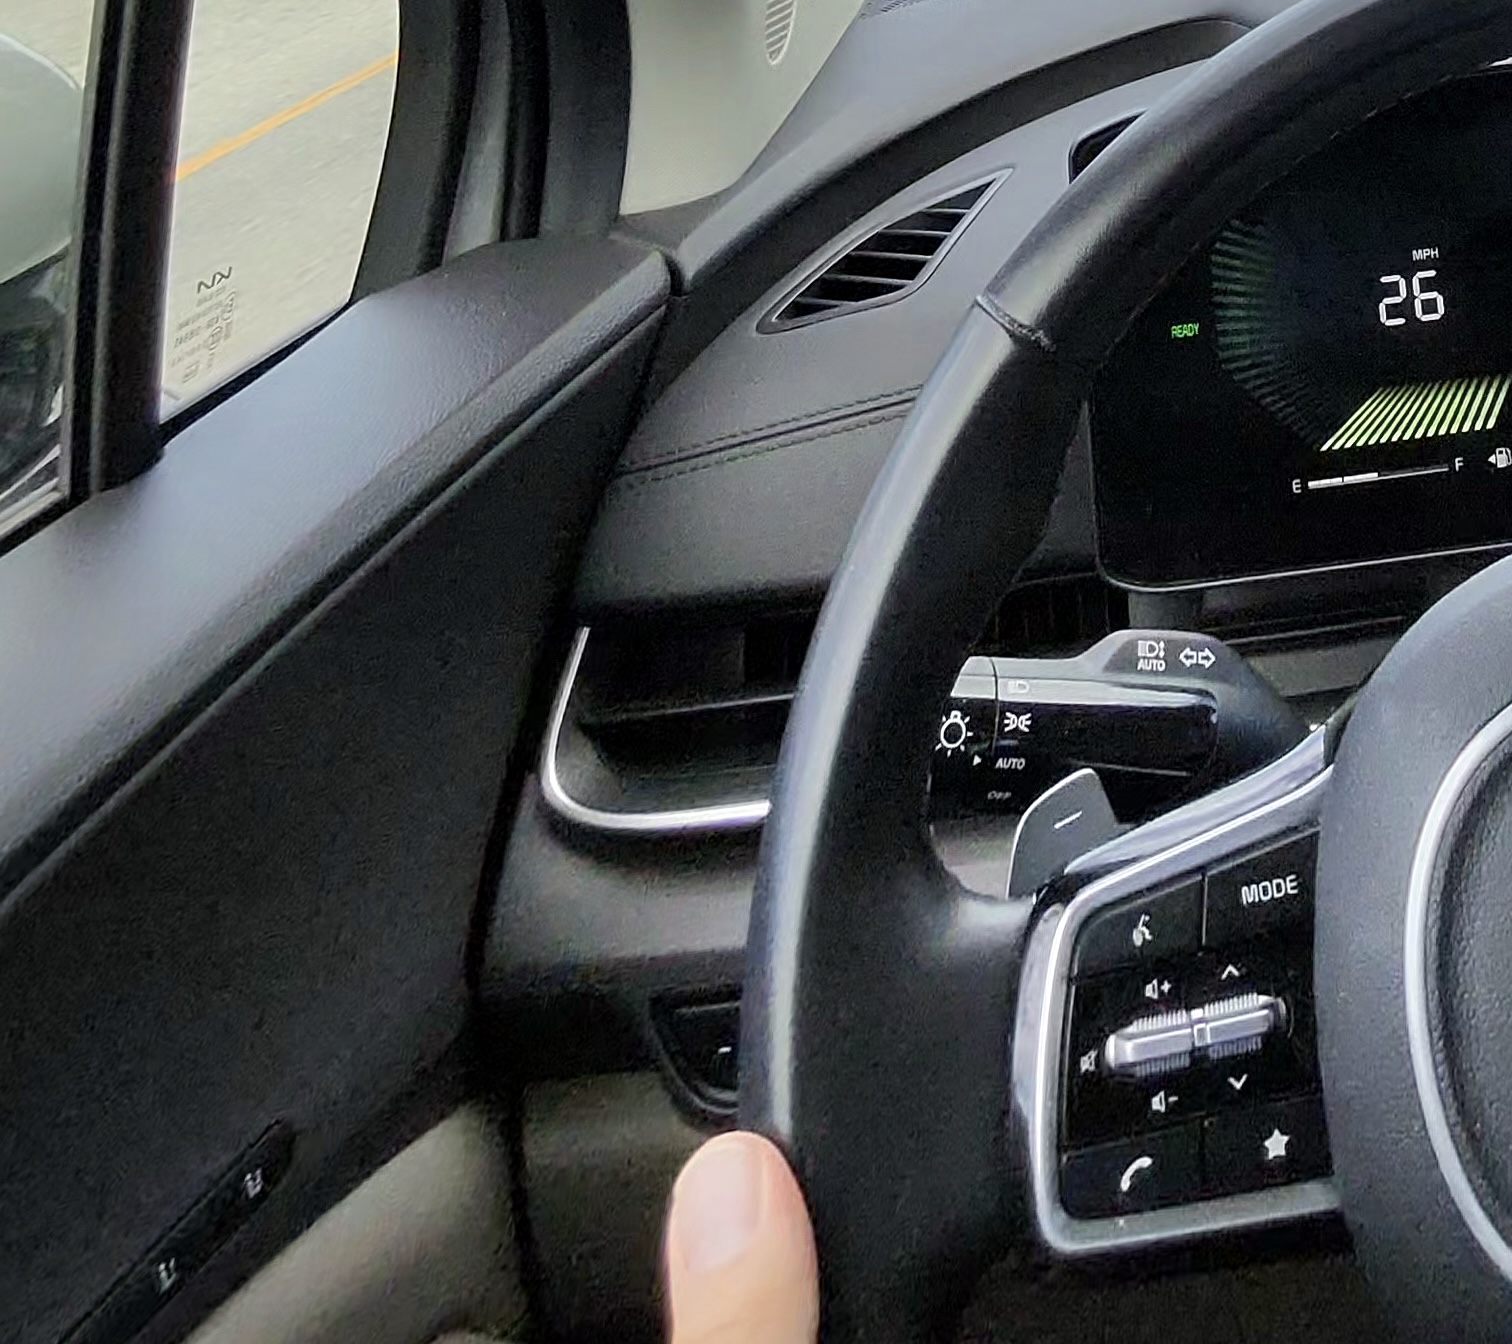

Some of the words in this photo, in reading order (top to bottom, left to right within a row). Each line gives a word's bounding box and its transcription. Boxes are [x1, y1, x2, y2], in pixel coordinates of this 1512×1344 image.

[1412, 247, 1439, 262] MPH
[1378, 269, 1445, 327] 26
[1171, 322, 1200, 339] READY
[1292, 479, 1302, 494] E
[1455, 457, 1464, 472] F
[1137, 658, 1166, 672] AUTO
[994, 756, 1026, 770] AUTO
[1241, 874, 1299, 906] MODE
